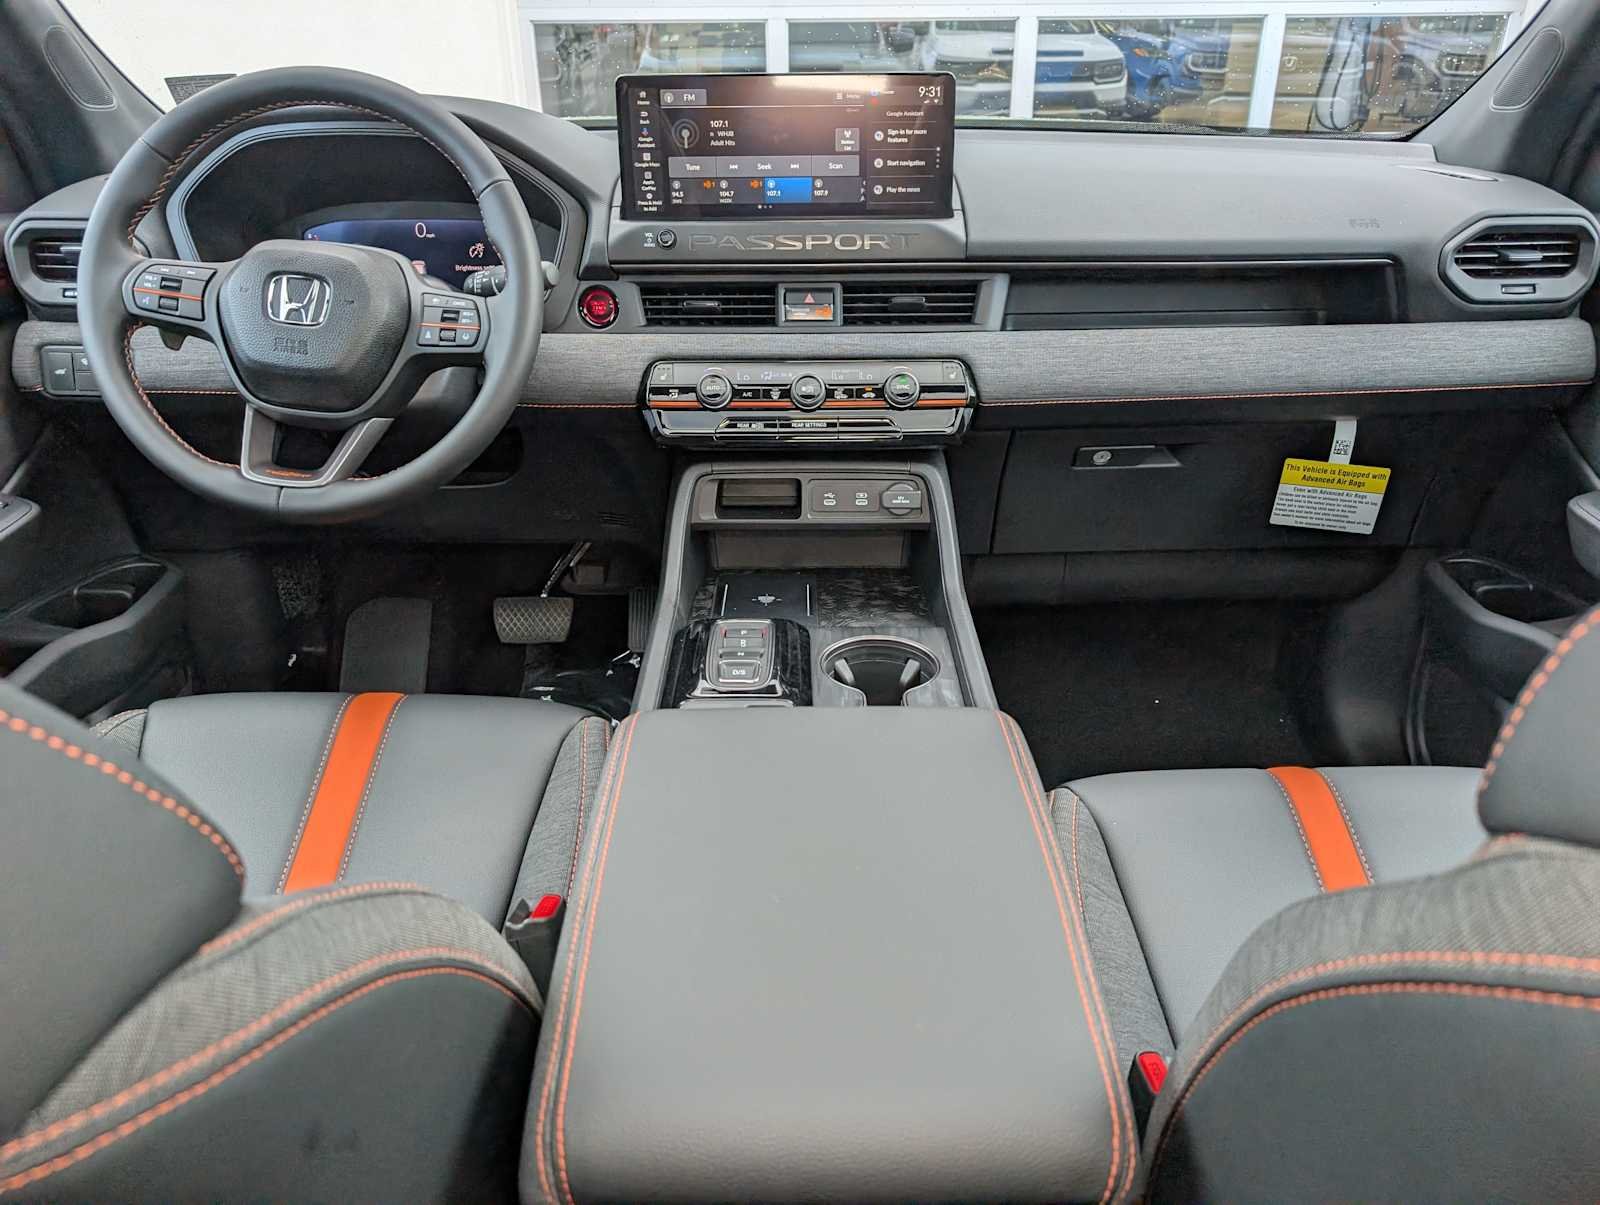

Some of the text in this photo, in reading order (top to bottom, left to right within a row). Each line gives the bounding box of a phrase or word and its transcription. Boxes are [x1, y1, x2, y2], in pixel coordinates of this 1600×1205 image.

[918, 86, 941, 97] 9:31
[683, 93, 696, 102] FM
[886, 110, 903, 118] Google
[710, 120, 729, 128] 107.1
[685, 163, 700, 171] Tune
[757, 163, 772, 171] Seek
[828, 162, 843, 170] Scan
[887, 159, 926, 168] Start navigation
[415, 222, 427, 238] 0
[688, 233, 918, 250] PASSPORT
[1286, 463, 1301, 472] This
[1302, 465, 1328, 475] Vehicle
[1337, 469, 1370, 479] Equipped
[1371, 472, 1387, 480] with
[1301, 474, 1335, 484] Advanced
[1348, 479, 1366, 488] Bags
